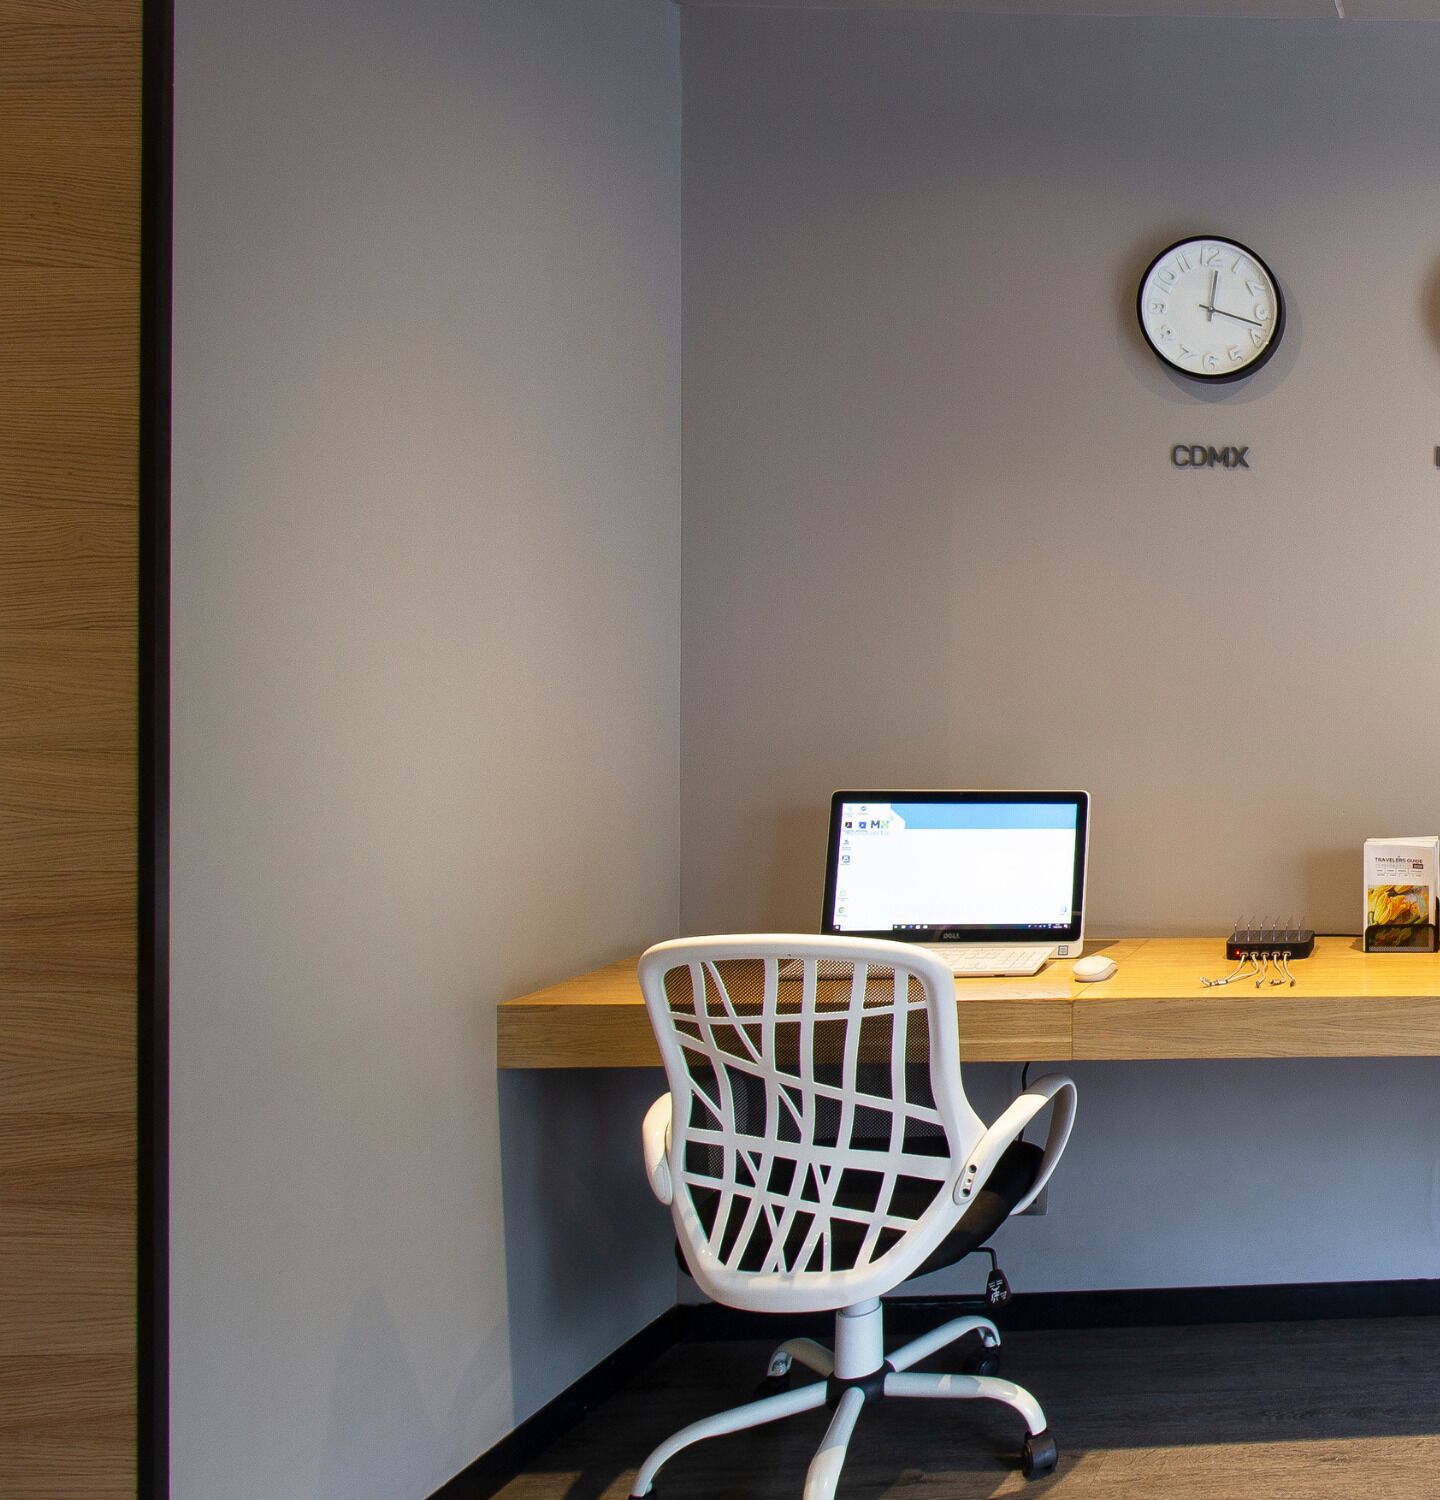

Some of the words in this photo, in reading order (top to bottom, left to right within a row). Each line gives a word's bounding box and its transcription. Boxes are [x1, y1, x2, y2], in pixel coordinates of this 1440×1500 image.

[1175, 252, 1191, 272] 11
[1199, 246, 1222, 266] 12
[1153, 270, 1176, 294] 10
[1245, 279, 1266, 296] 2
[1203, 352, 1217, 369] 6
[1227, 346, 1244, 362] 5
[1171, 444, 1250, 469] CDMX
